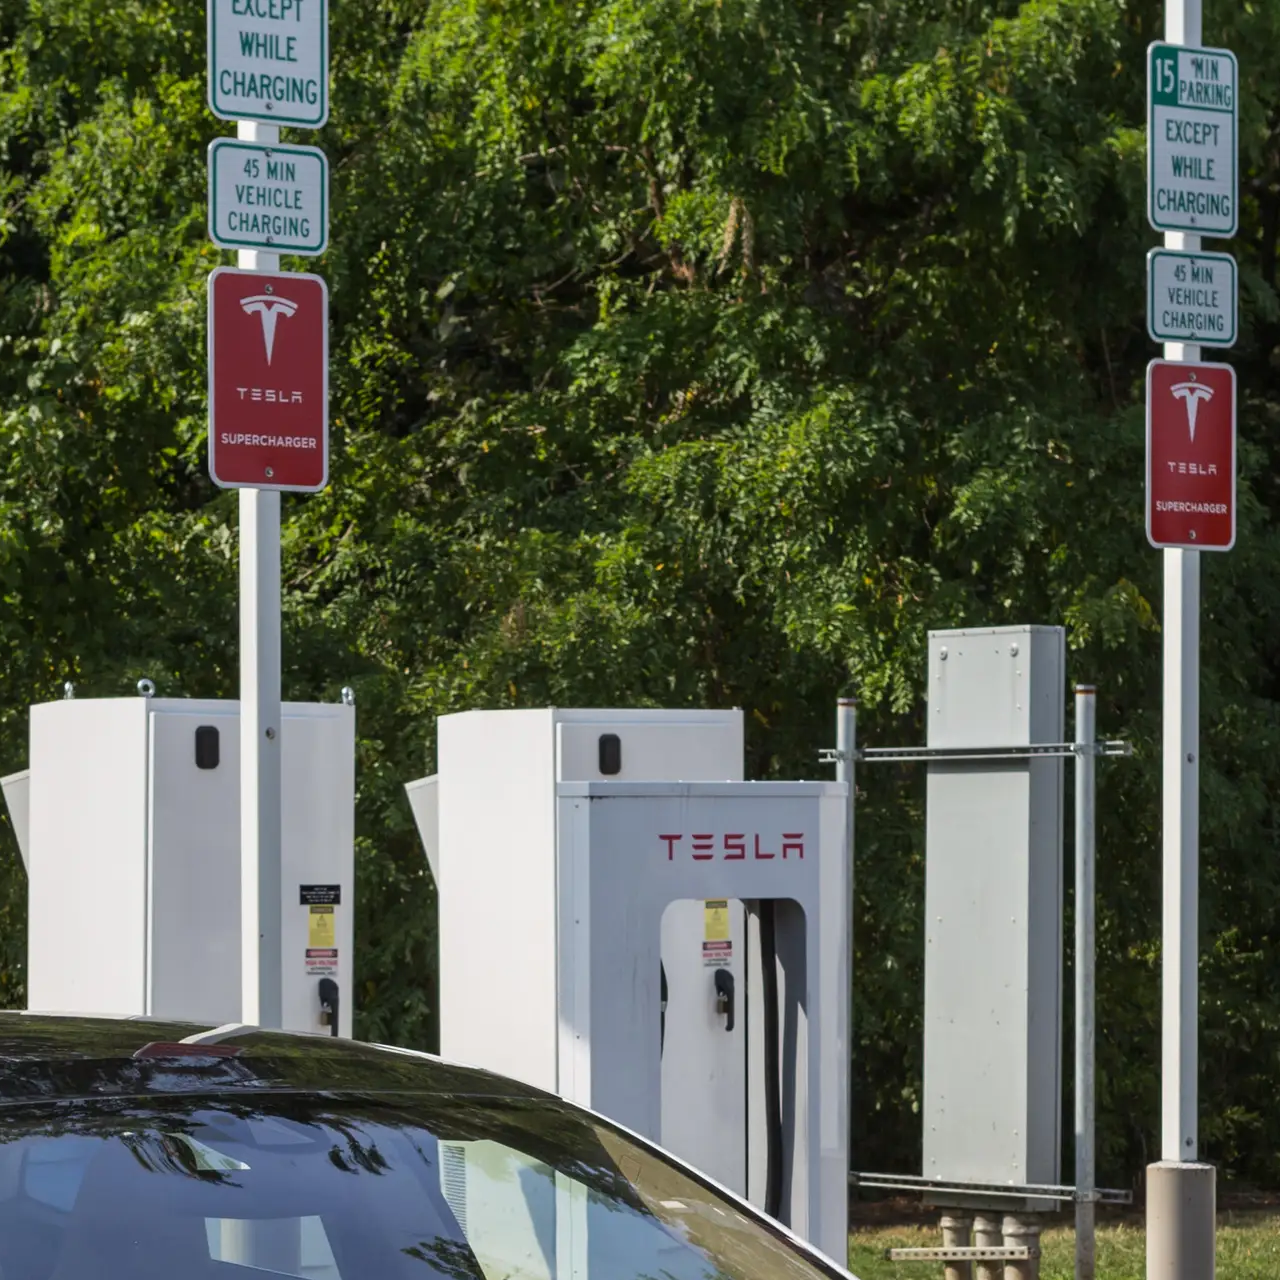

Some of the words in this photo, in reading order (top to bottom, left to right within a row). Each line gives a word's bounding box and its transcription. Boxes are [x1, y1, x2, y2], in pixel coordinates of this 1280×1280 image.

[231, 0, 303, 22] EXCEPT
[239, 31, 298, 62] WHILE
[1155, 58, 1175, 93] 15
[1195, 58, 1219, 81] MIN
[220, 69, 317, 105] CHARGING
[1179, 80, 1232, 107] PARKING
[1165, 119, 1220, 146] EXCEPT
[243, 158, 260, 179] 45
[267, 161, 296, 182] MIN
[1171, 155, 1216, 181] WHILE
[235, 184, 303, 210] VEHICLE
[1156, 188, 1230, 217] CHARGING
[228, 211, 310, 238] CHARGING
[1173, 264, 1186, 283] 45
[1191, 265, 1213, 285] MIN
[1168, 287, 1219, 309] VEHICLE
[1162, 310, 1224, 332] CHARGING
[236, 387, 303, 404] TESLA
[221, 432, 317, 449] SUPERCHARGER
[1167, 461, 1217, 476] TESLA
[1156, 500, 1227, 515] SUPERCHARGER
[658, 832, 804, 861] TESLA
